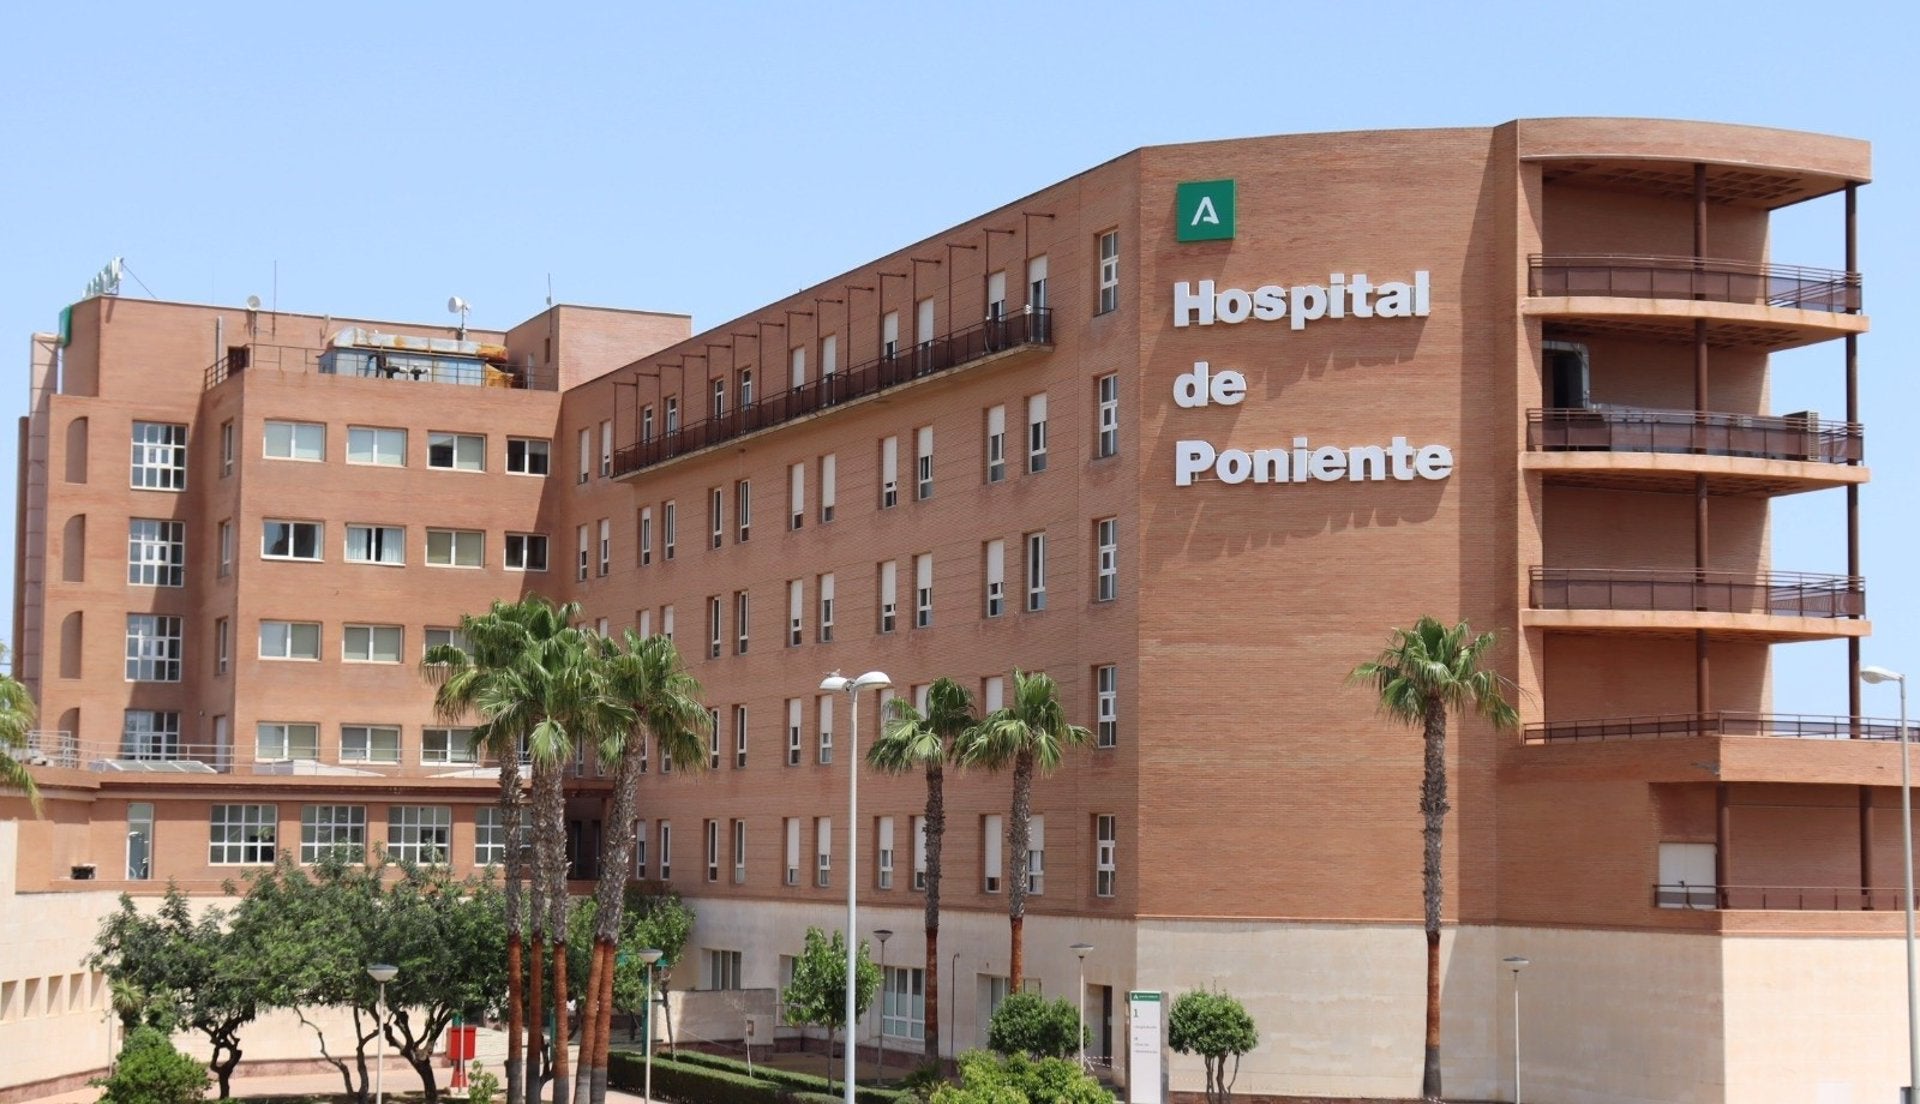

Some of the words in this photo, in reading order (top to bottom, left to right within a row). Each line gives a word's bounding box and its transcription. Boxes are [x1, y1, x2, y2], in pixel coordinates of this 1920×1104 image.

[1190, 196, 1220, 226] A
[1174, 270, 1430, 330] Hospital
[1173, 361, 1247, 408] de
[1175, 436, 1453, 486] Poniente
[1134, 1008, 1138, 1018] 1
